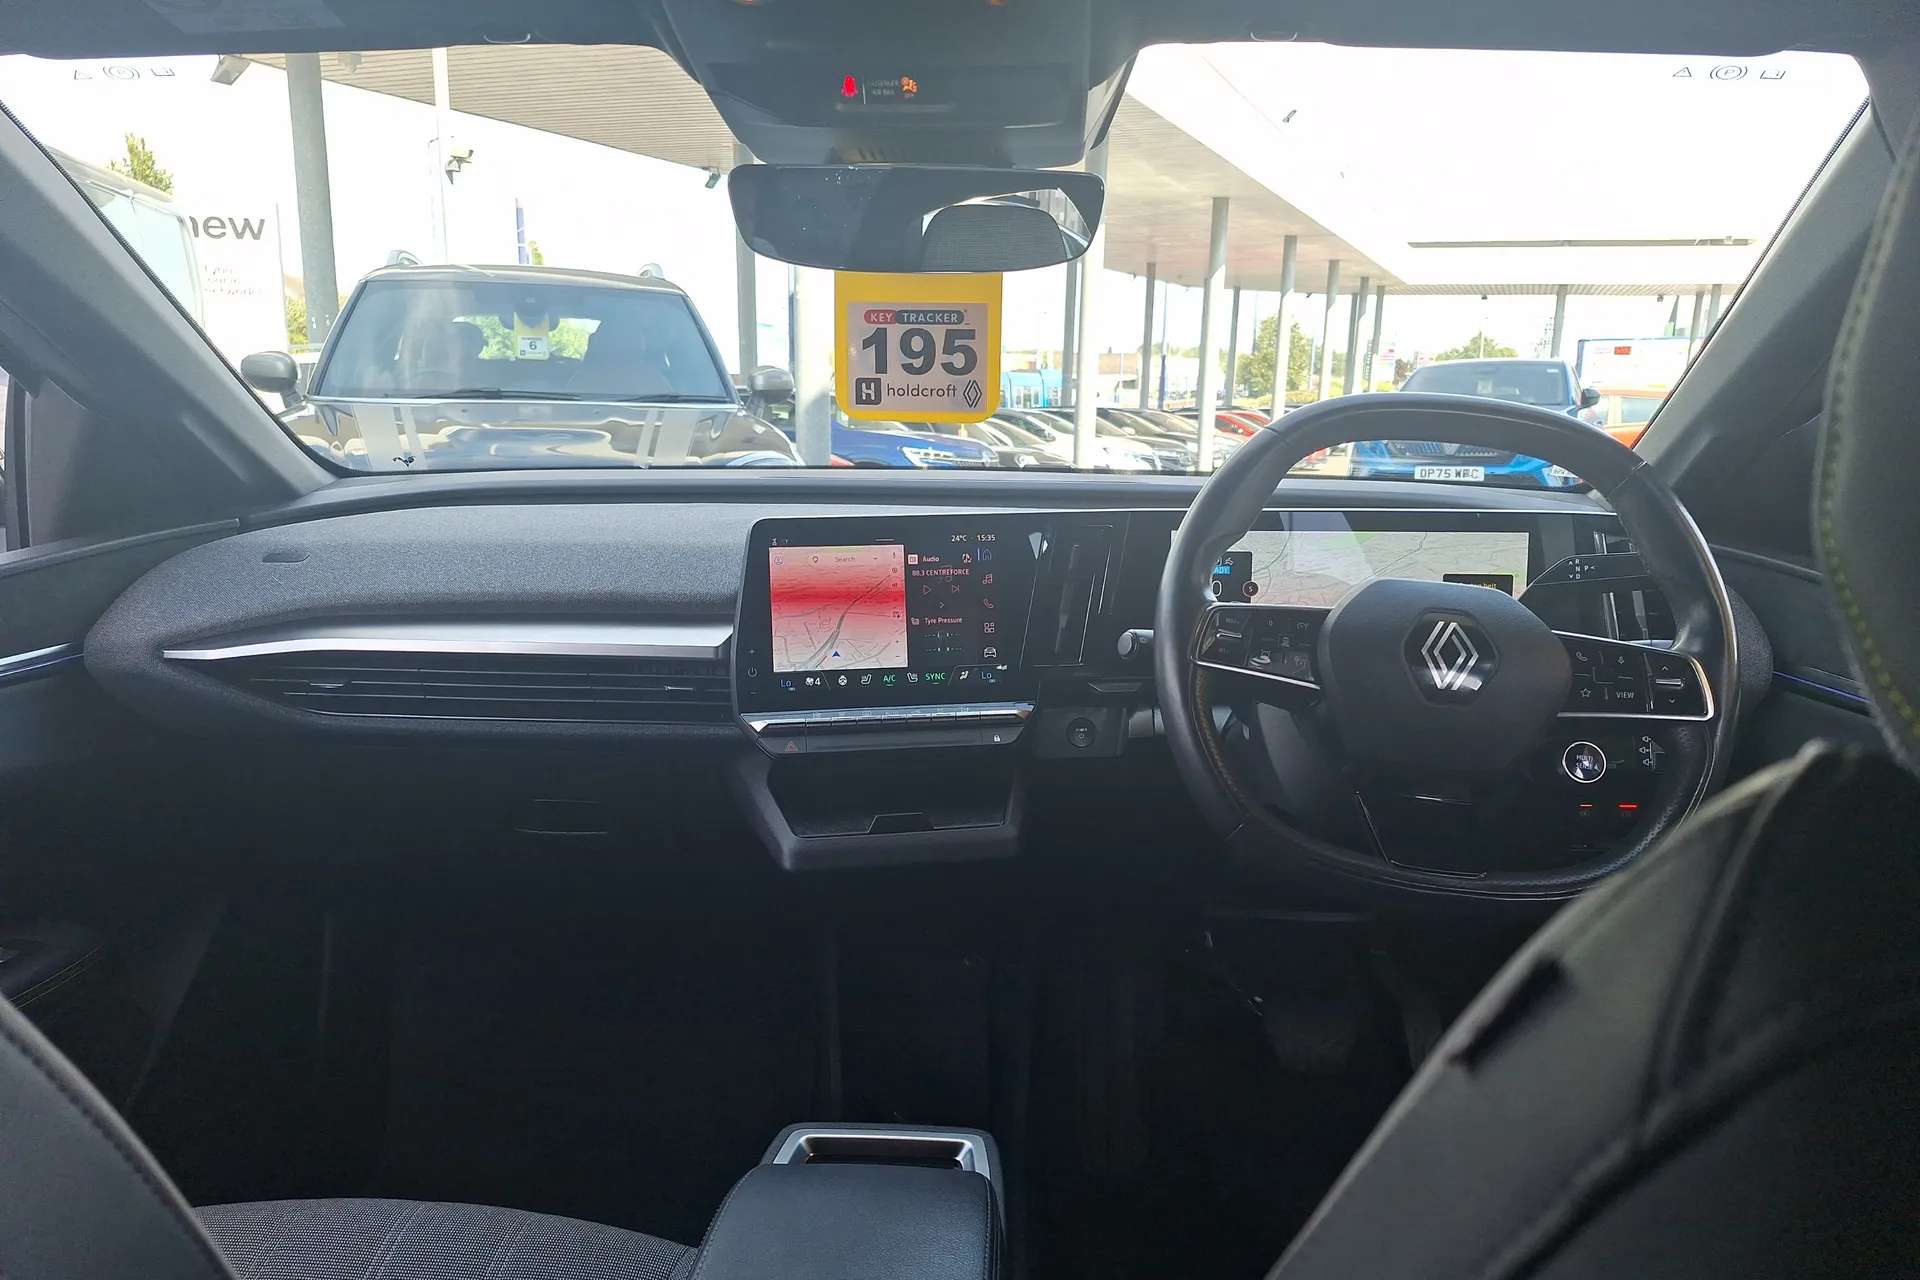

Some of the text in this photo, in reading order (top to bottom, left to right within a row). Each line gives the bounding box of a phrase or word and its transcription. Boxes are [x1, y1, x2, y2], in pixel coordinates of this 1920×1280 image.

[870, 313, 958, 323] KEY TRACKER
[529, 341, 537, 350] 6
[862, 327, 978, 376] 195
[887, 383, 958, 398] holdcroft
[976, 534, 996, 542] 15:35
[924, 617, 936, 625] Tyre
[883, 674, 896, 682] A/C
[925, 672, 946, 681] SYNC
[815, 678, 821, 686] 4
[1616, 691, 1635, 699] VIEW
